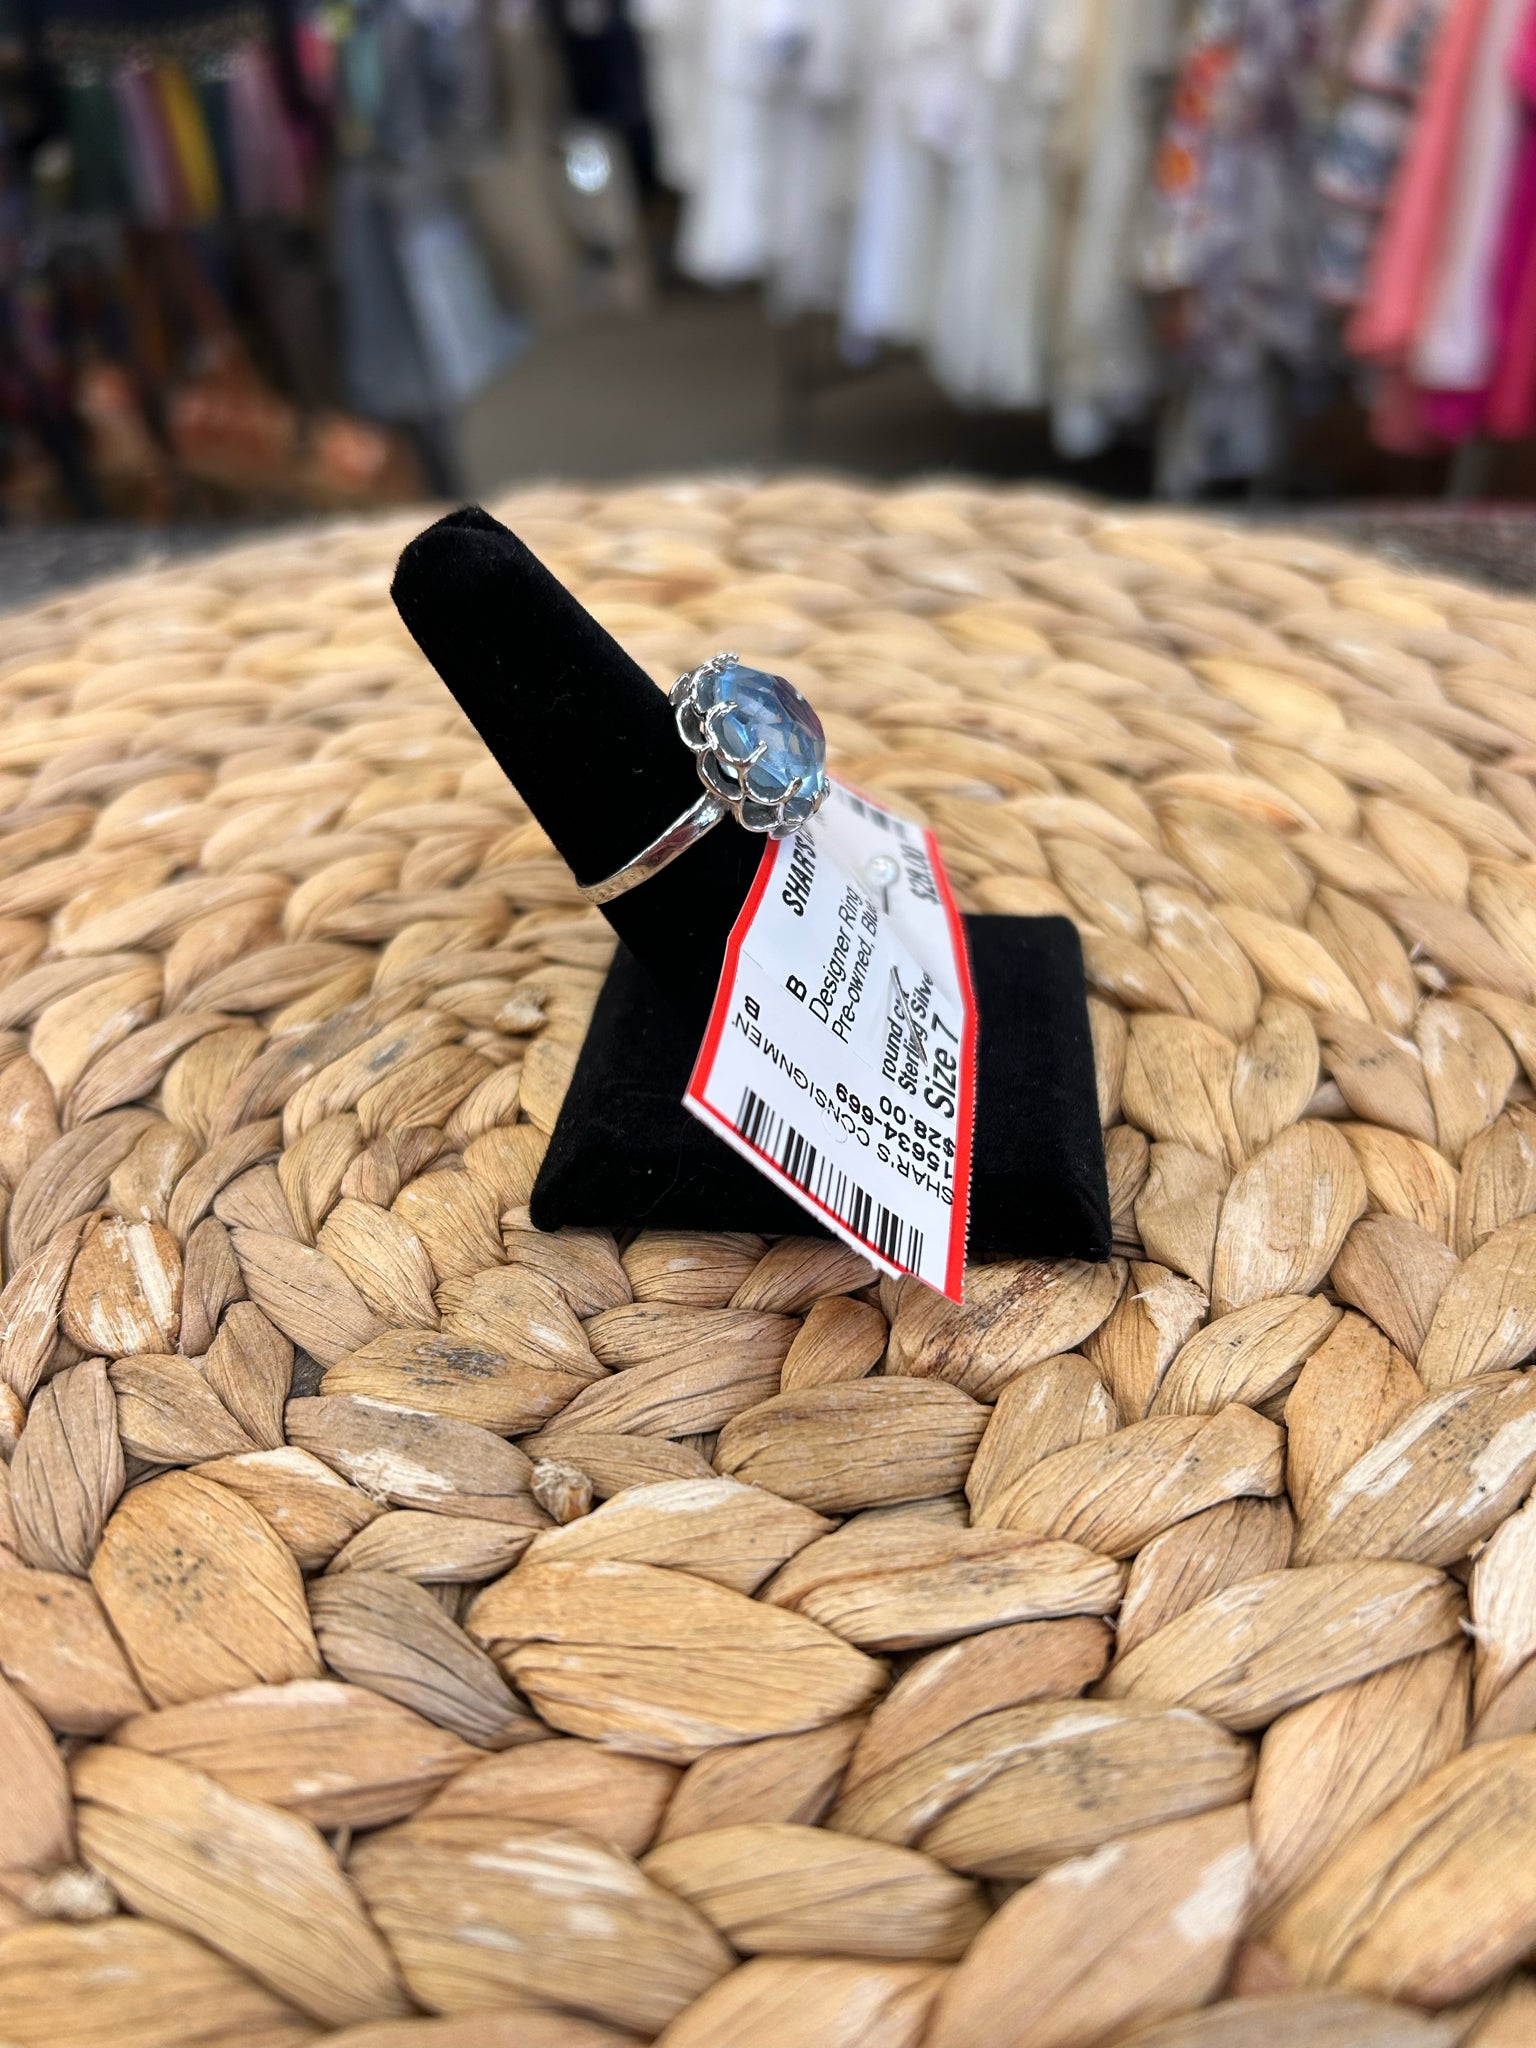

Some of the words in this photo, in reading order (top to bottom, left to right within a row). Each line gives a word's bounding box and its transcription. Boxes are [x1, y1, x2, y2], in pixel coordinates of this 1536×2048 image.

[781, 834, 818, 917] SHAR'S
[808, 925, 852, 1024] Designer
[838, 885, 863, 933] Ring
[744, 995, 761, 1020] B
[785, 974, 809, 1003] B
[831, 933, 876, 1044] Pre-owned,
[882, 1016, 903, 1082] round
[930, 1013, 959, 1044] 7
[923, 1050, 958, 1119] Size
[835, 1082, 953, 1180] 15634-669
[879, 1095, 955, 1158] $28.00
[877, 1143, 955, 1206] SHAR'S
